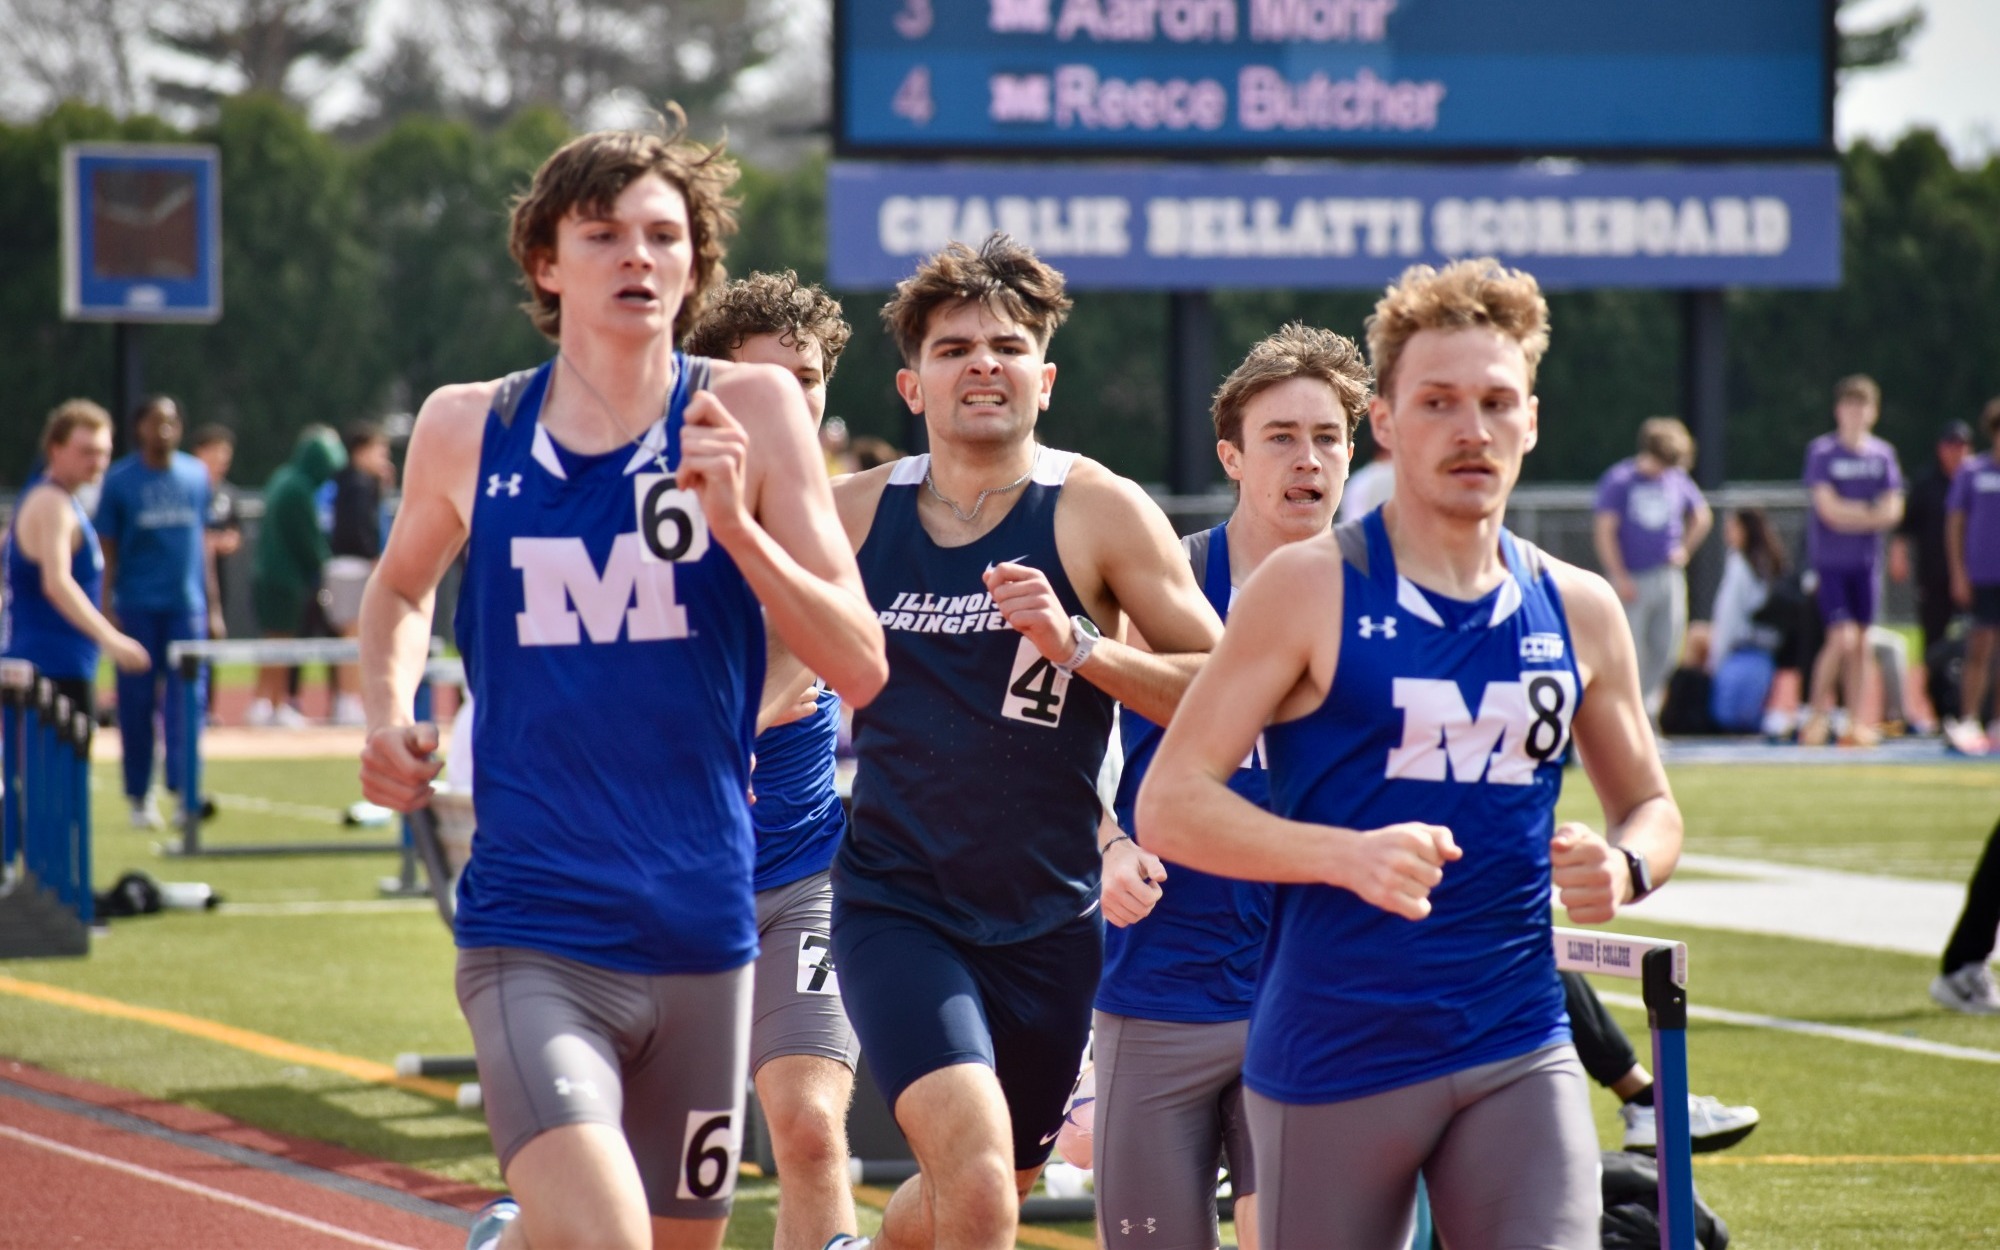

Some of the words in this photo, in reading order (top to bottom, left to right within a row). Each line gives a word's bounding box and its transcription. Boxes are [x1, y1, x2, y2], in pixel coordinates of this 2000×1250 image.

[1056, 0, 1238, 41] Aaron
[893, 66, 934, 126] 4
[1055, 65, 1226, 129] Reece
[1238, 66, 1442, 130] Butcher
[879, 197, 1129, 256] CHARLIE
[1147, 197, 1423, 257] BELLATTI
[1432, 197, 1790, 256] SCOREBOARD
[642, 478, 693, 561] 6
[511, 532, 689, 647] M
[878, 611, 1015, 634] PRINGFIE
[1010, 655, 1061, 724] 4
[1525, 676, 1565, 759] 8
[1385, 677, 1538, 785] M
[802, 935, 834, 992] 7
[1602, 944, 1630, 968] COLLEGE
[686, 1115, 731, 1199] 6
